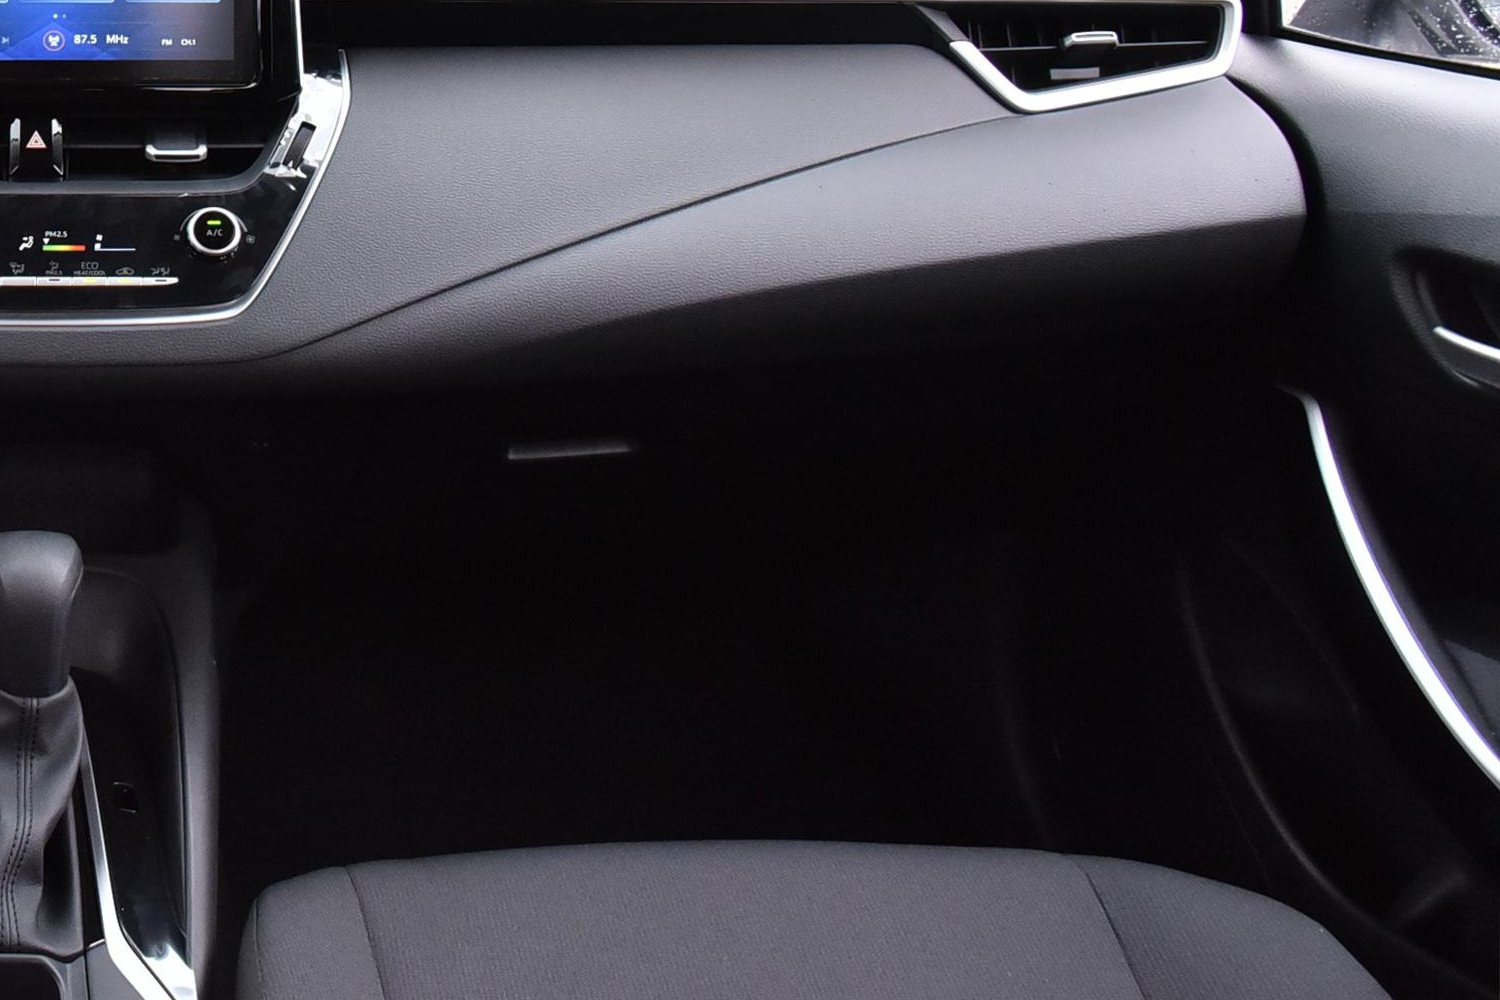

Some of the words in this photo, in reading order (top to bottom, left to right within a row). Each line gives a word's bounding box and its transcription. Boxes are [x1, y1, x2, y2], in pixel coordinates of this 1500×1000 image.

[74, 35, 97, 44] 87.5
[106, 35, 129, 44] MHz
[206, 229, 224, 237] A/C
[81, 262, 99, 270] ECO
